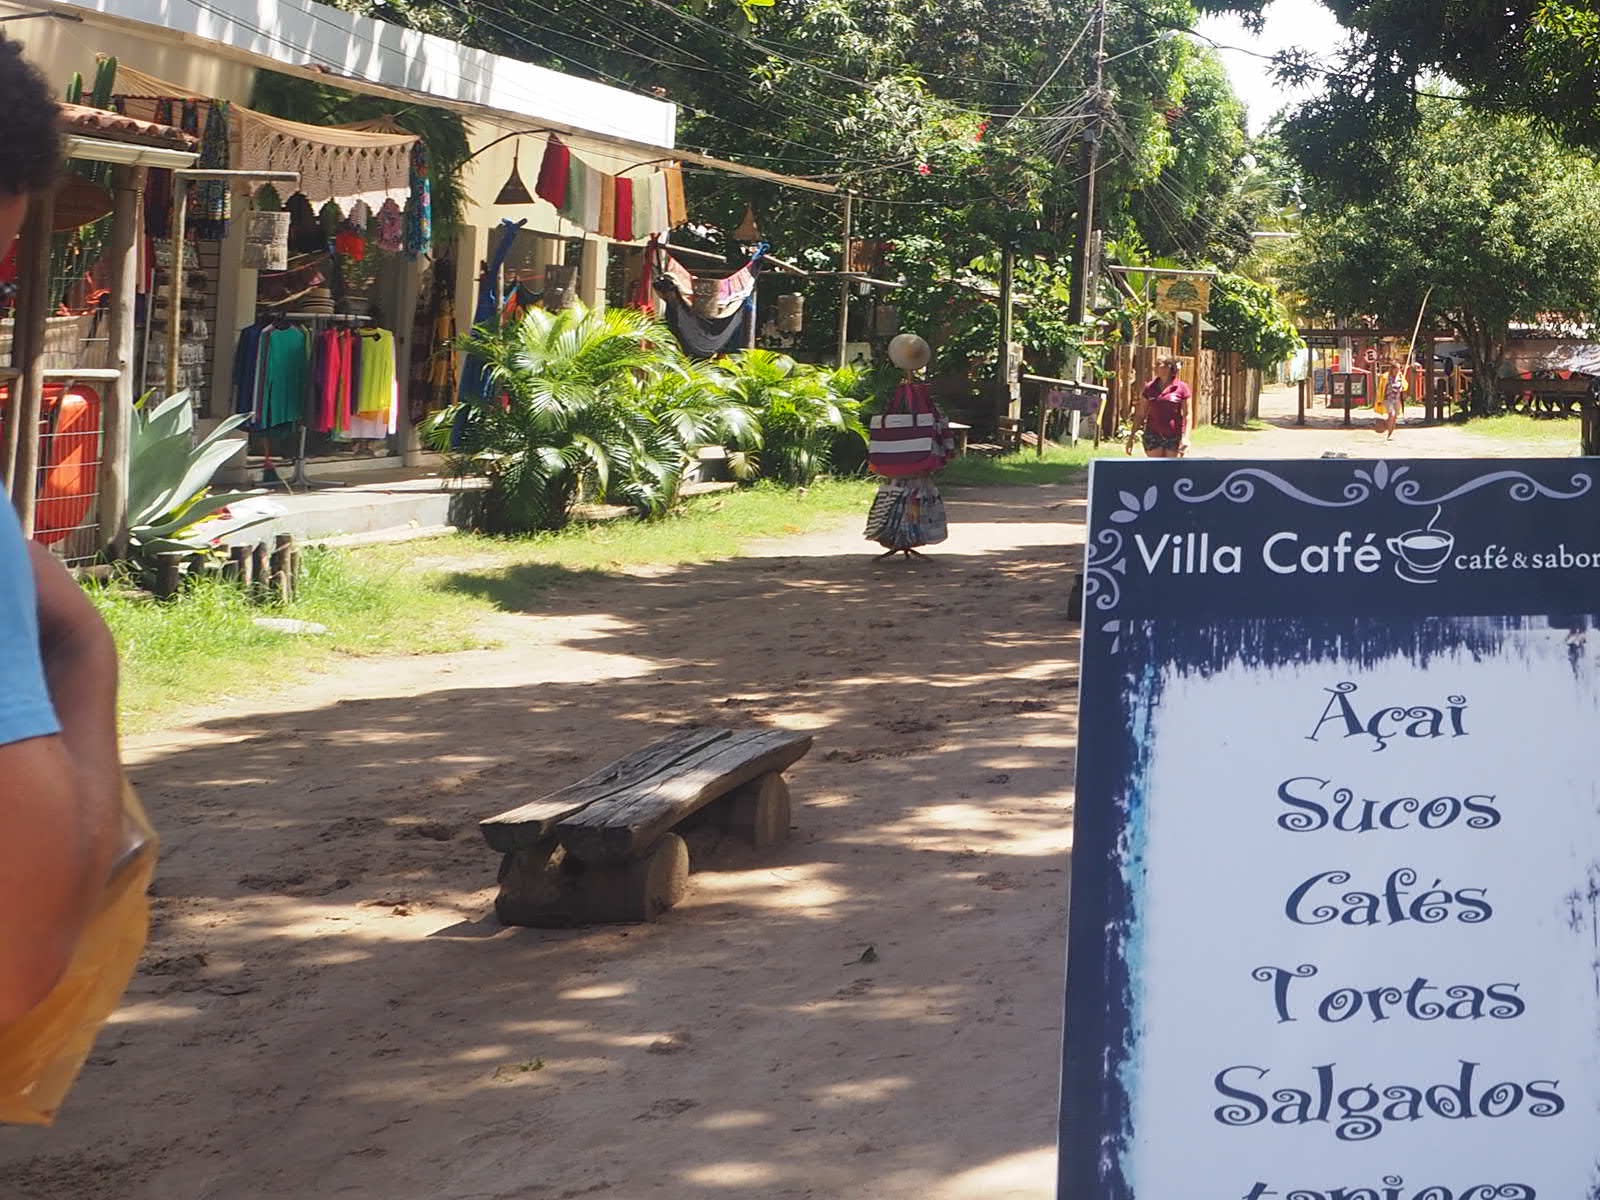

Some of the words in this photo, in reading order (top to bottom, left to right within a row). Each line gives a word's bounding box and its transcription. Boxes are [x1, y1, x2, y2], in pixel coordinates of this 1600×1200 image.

[1134, 533, 1241, 577] Villa
[1262, 531, 1381, 575] Café
[1277, 776, 1503, 835] Sucos
[1285, 867, 1494, 926] Cafés
[1251, 963, 1527, 1024] Tortas
[1213, 1059, 1566, 1142] Salgados
